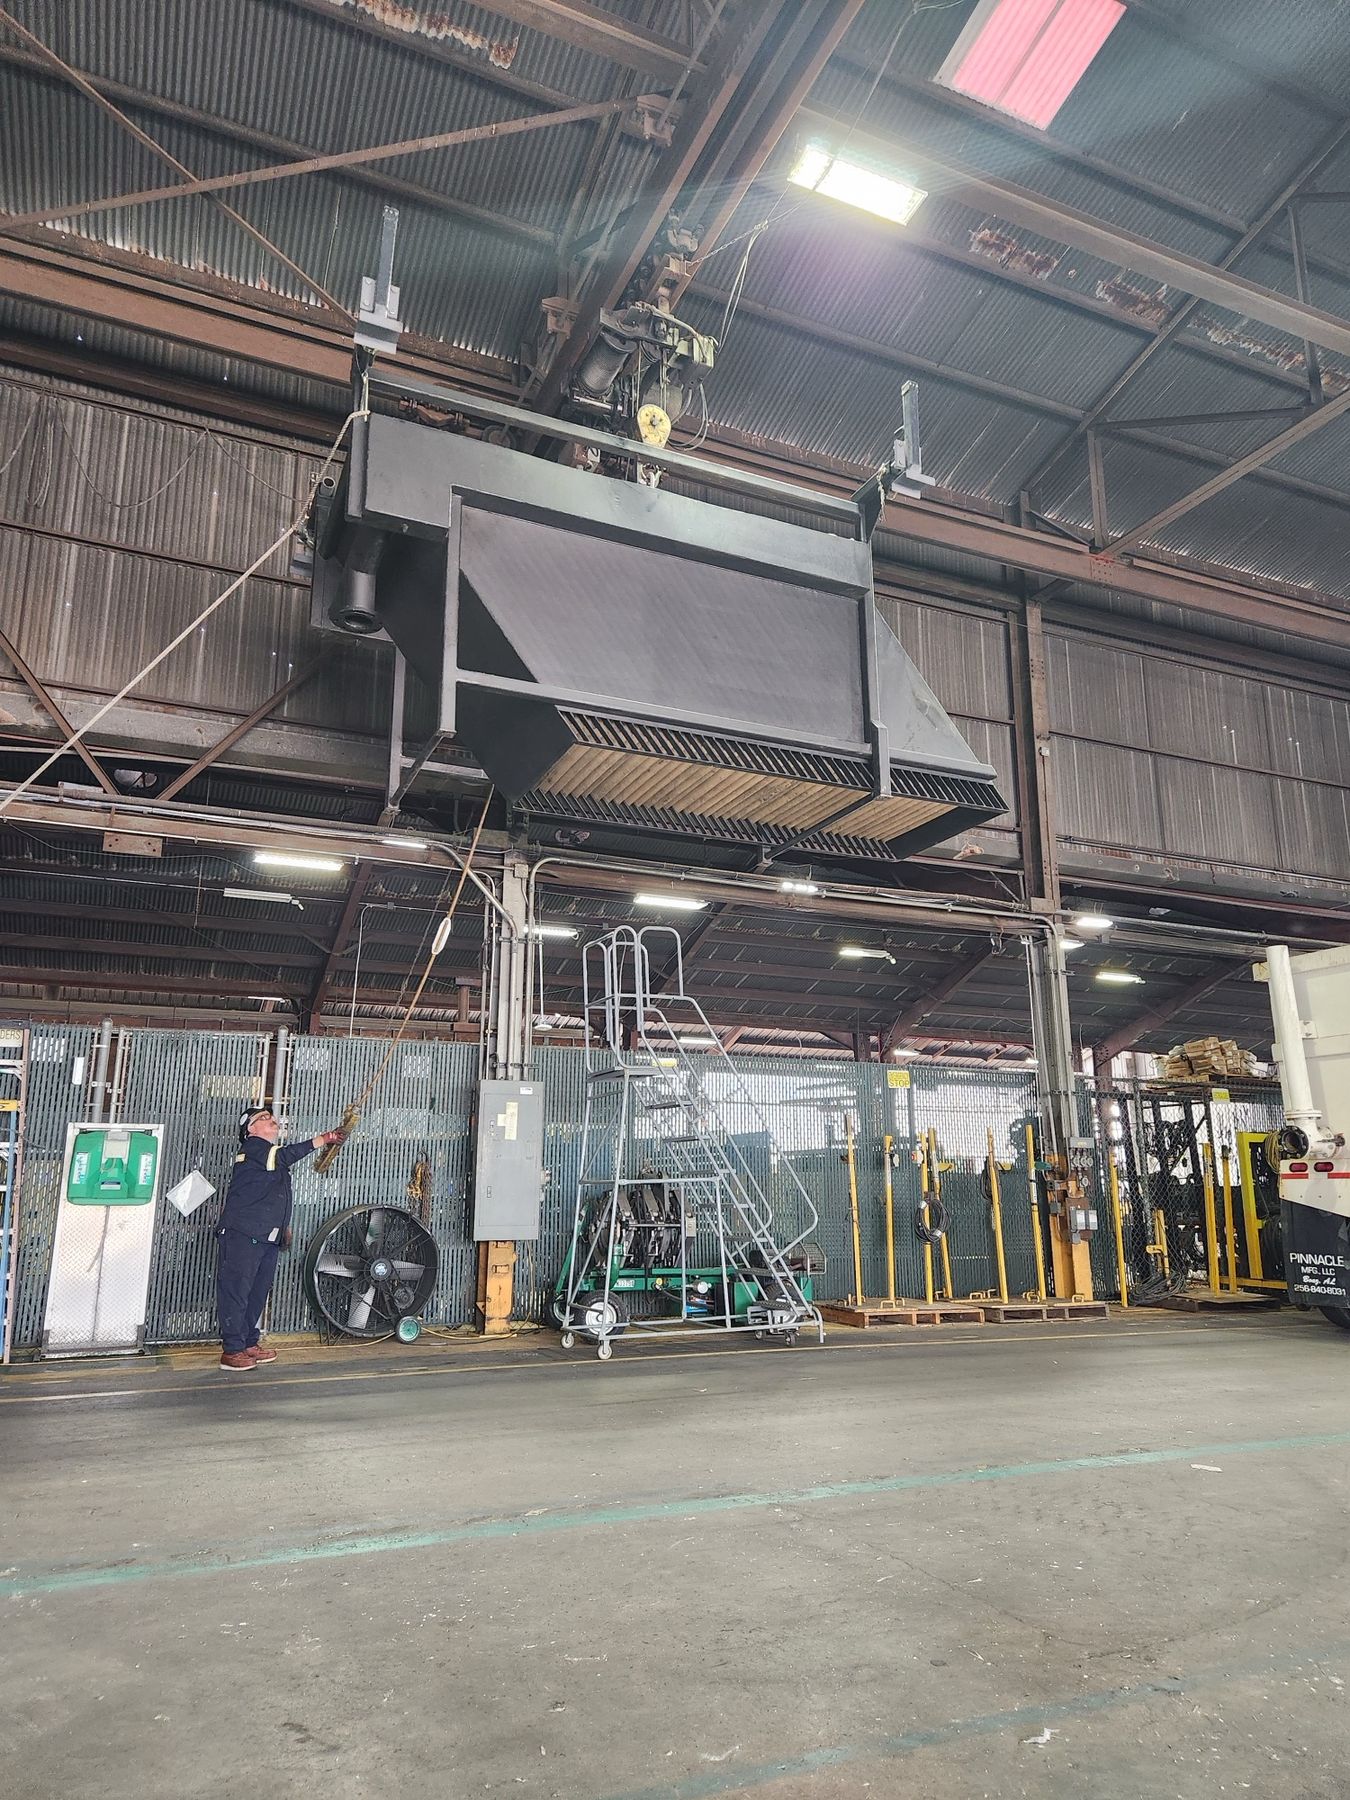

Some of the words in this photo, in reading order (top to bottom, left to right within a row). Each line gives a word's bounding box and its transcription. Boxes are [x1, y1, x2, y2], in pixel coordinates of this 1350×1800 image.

[889, 1079, 909, 1087] STOP
[1289, 1252, 1344, 1267] PINNACLE
[1321, 1267, 1336, 1276] LLC
[1294, 1284, 1346, 1296] 256-840-8031
